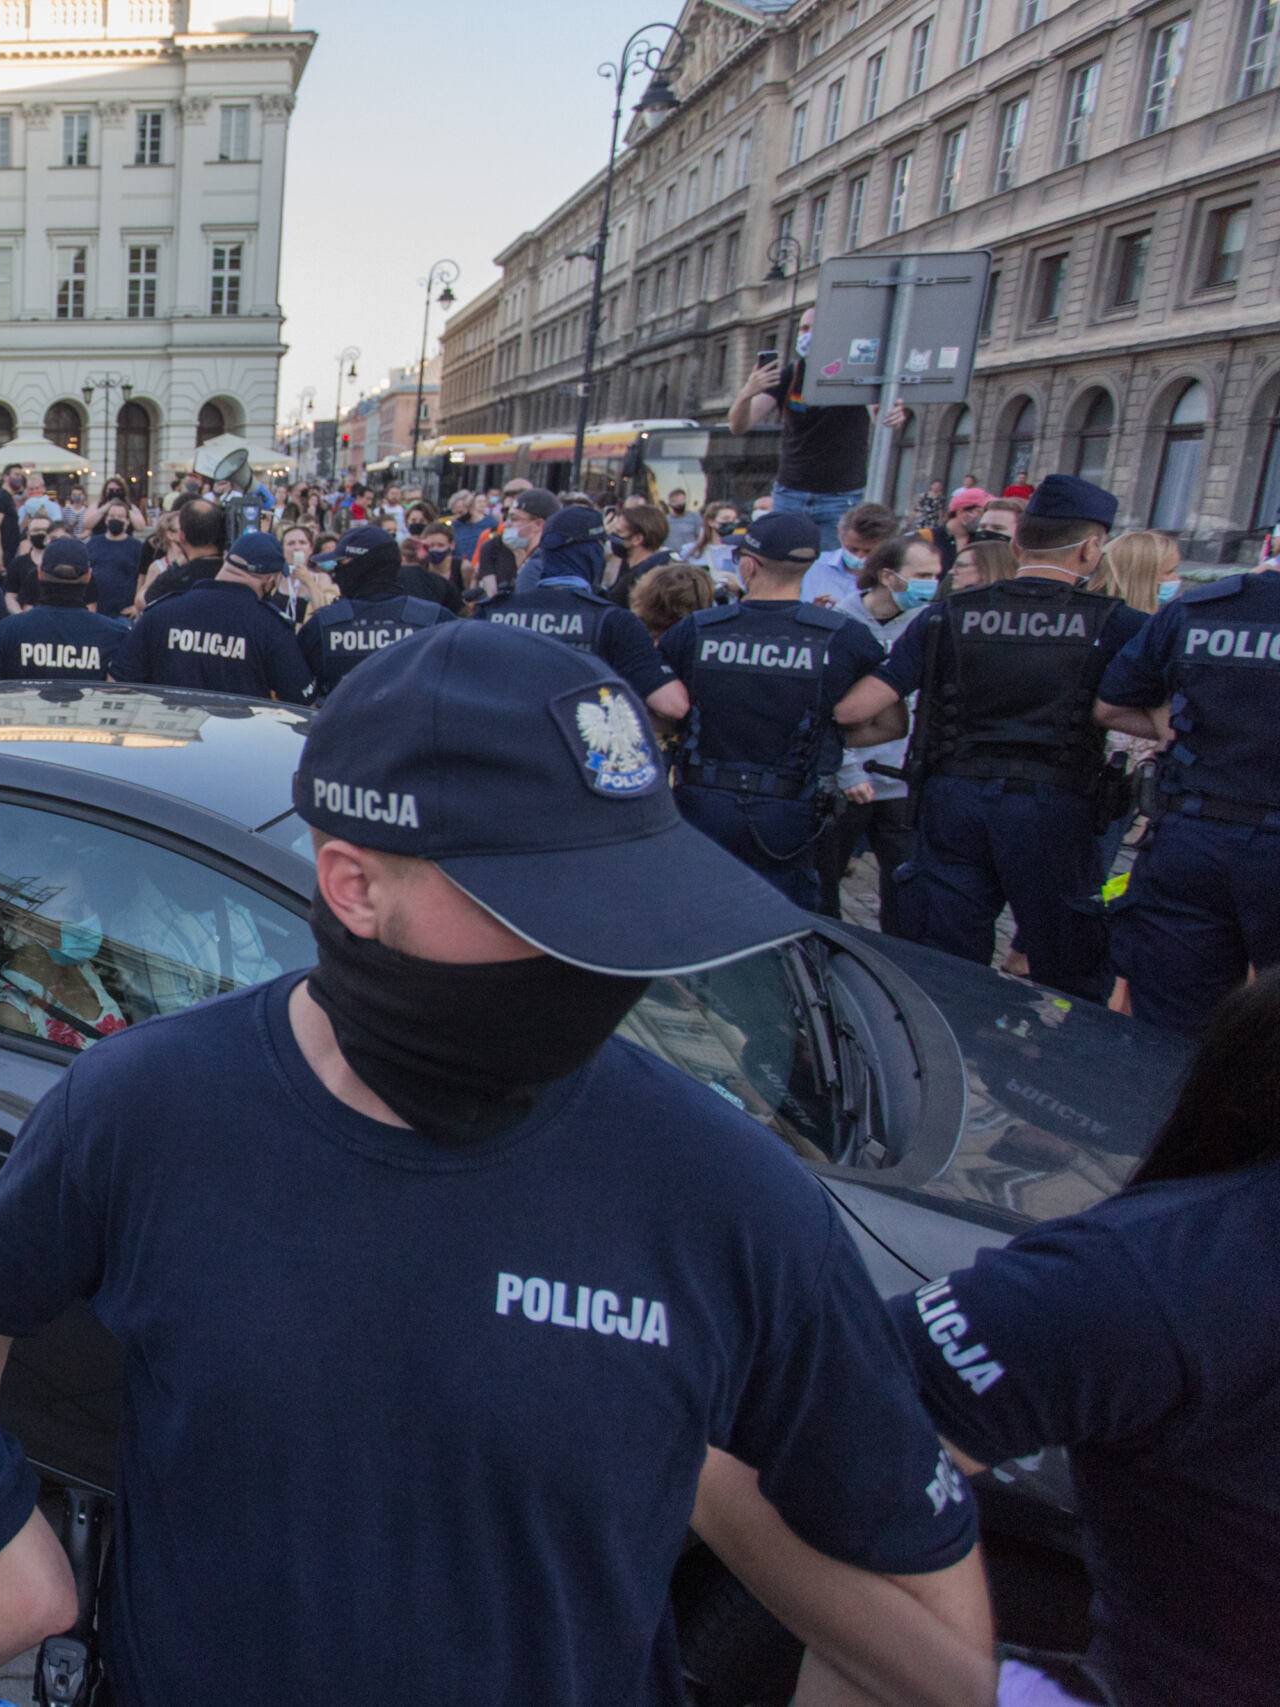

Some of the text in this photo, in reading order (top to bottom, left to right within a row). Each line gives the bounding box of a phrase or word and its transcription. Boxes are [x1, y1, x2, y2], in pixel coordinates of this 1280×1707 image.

[961, 609, 1086, 638] POLICJA
[20, 642, 101, 670] POLICJA
[168, 628, 246, 660] POLICJA
[700, 639, 813, 670] POLICJA
[314, 778, 419, 830] POLICJA
[495, 1271, 669, 1347] POLICJA
